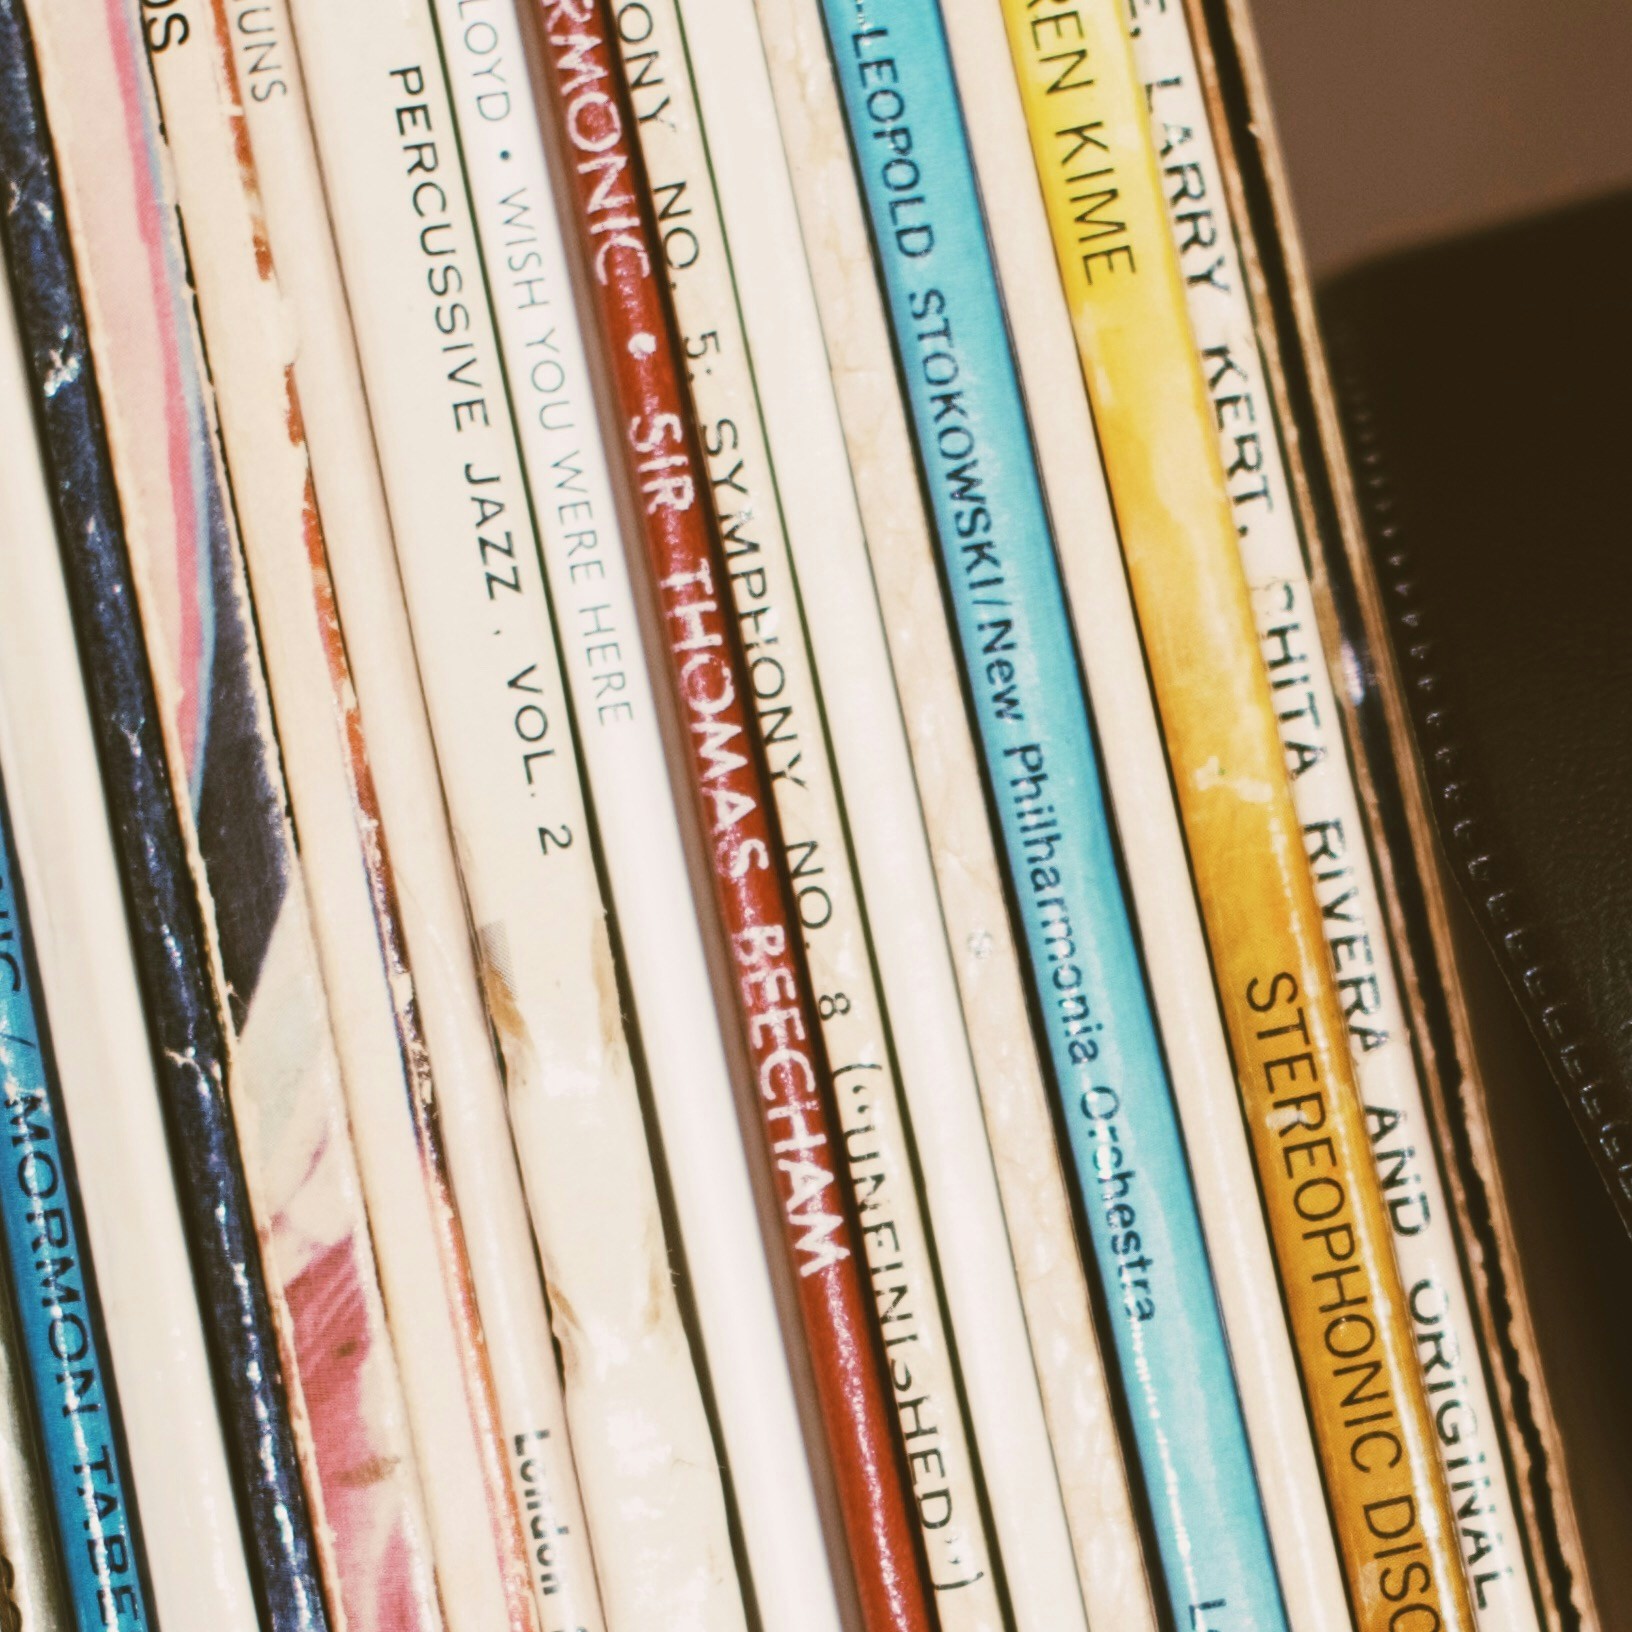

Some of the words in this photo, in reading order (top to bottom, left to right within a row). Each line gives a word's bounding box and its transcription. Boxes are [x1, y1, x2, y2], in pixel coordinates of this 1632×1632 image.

[499, 186, 550, 311] WISH
[1055, 120, 1136, 286] KIME
[389, 65, 490, 433] PERCUSSIVE
[464, 460, 524, 603] JAZZ
[537, 823, 573, 856] 2
[524, 326, 574, 436] YOU
[549, 452, 606, 584] WERE
[629, 413, 695, 514] SIR
[580, 603, 634, 726] HERE
[659, 556, 769, 880] THOMAS
[699, 417, 806, 792] SYMPHONY
[818, 992, 851, 1023] 8
[851, 27, 935, 261] LEOPOLD
[1003, 742, 1103, 1068] Philharmonia
[1080, 1085, 1156, 1324] Orchestra
[1144, 75, 1231, 297] LARRY
[1304, 818, 1390, 1054] RIVERA
[1365, 1104, 1431, 1238] AND
[1409, 1276, 1514, 1609] ORIGINAL
[10, 1093, 98, 1418] MORMON
[731, 923, 851, 1278] BEECHAM
[1247, 970, 1402, 1475] STEREOPHONIC
